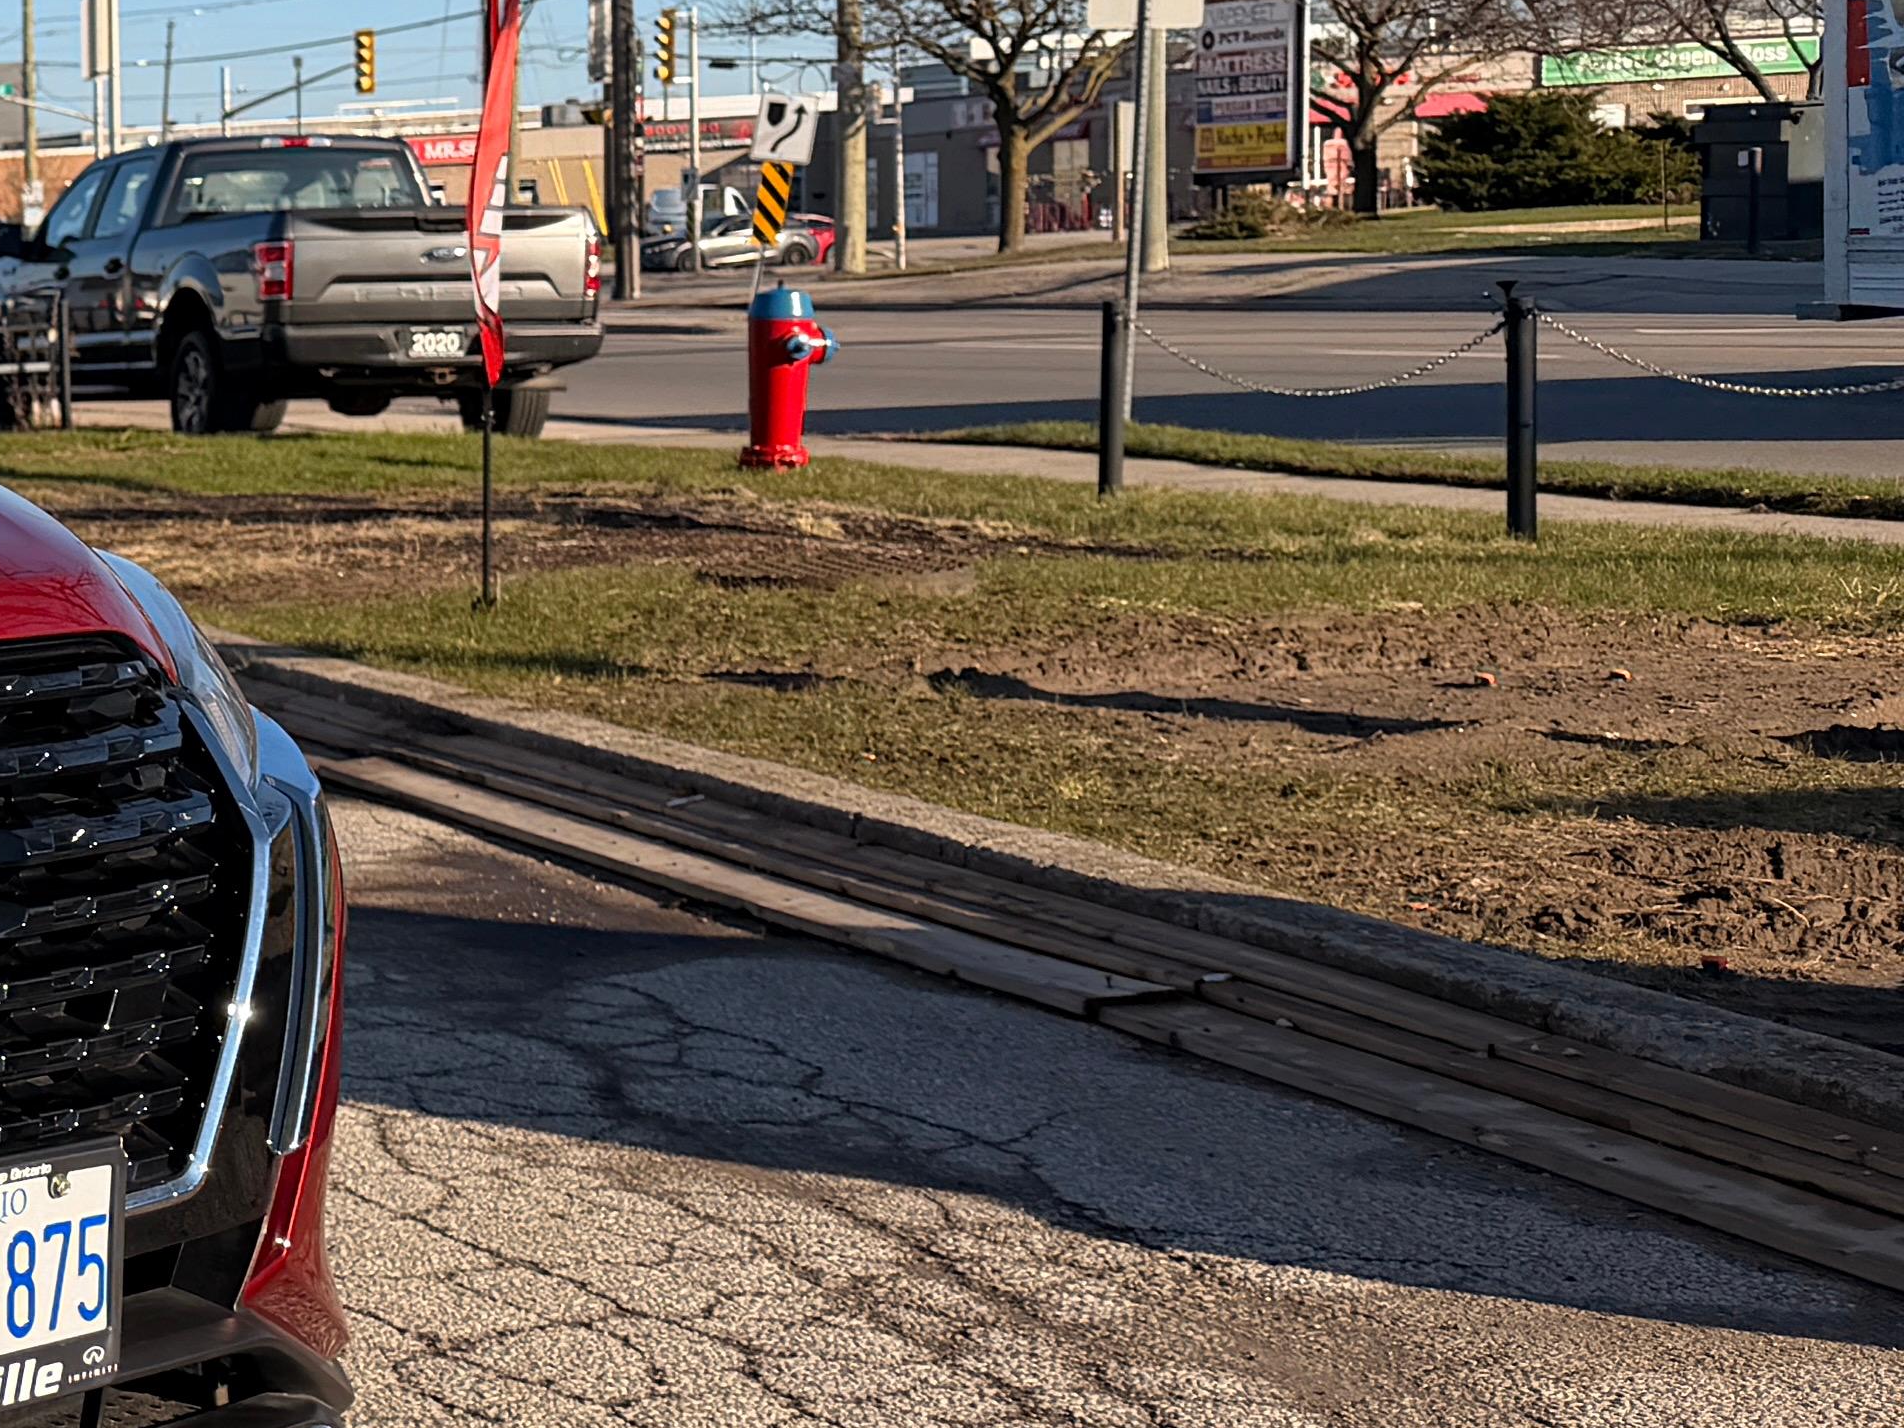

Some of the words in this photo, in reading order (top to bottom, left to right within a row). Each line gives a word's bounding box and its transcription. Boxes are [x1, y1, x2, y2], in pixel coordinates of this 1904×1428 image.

[411, 332, 461, 353] 2020
[10, 1162, 53, 1181] Ontario
[6, 1213, 108, 1339] 875
